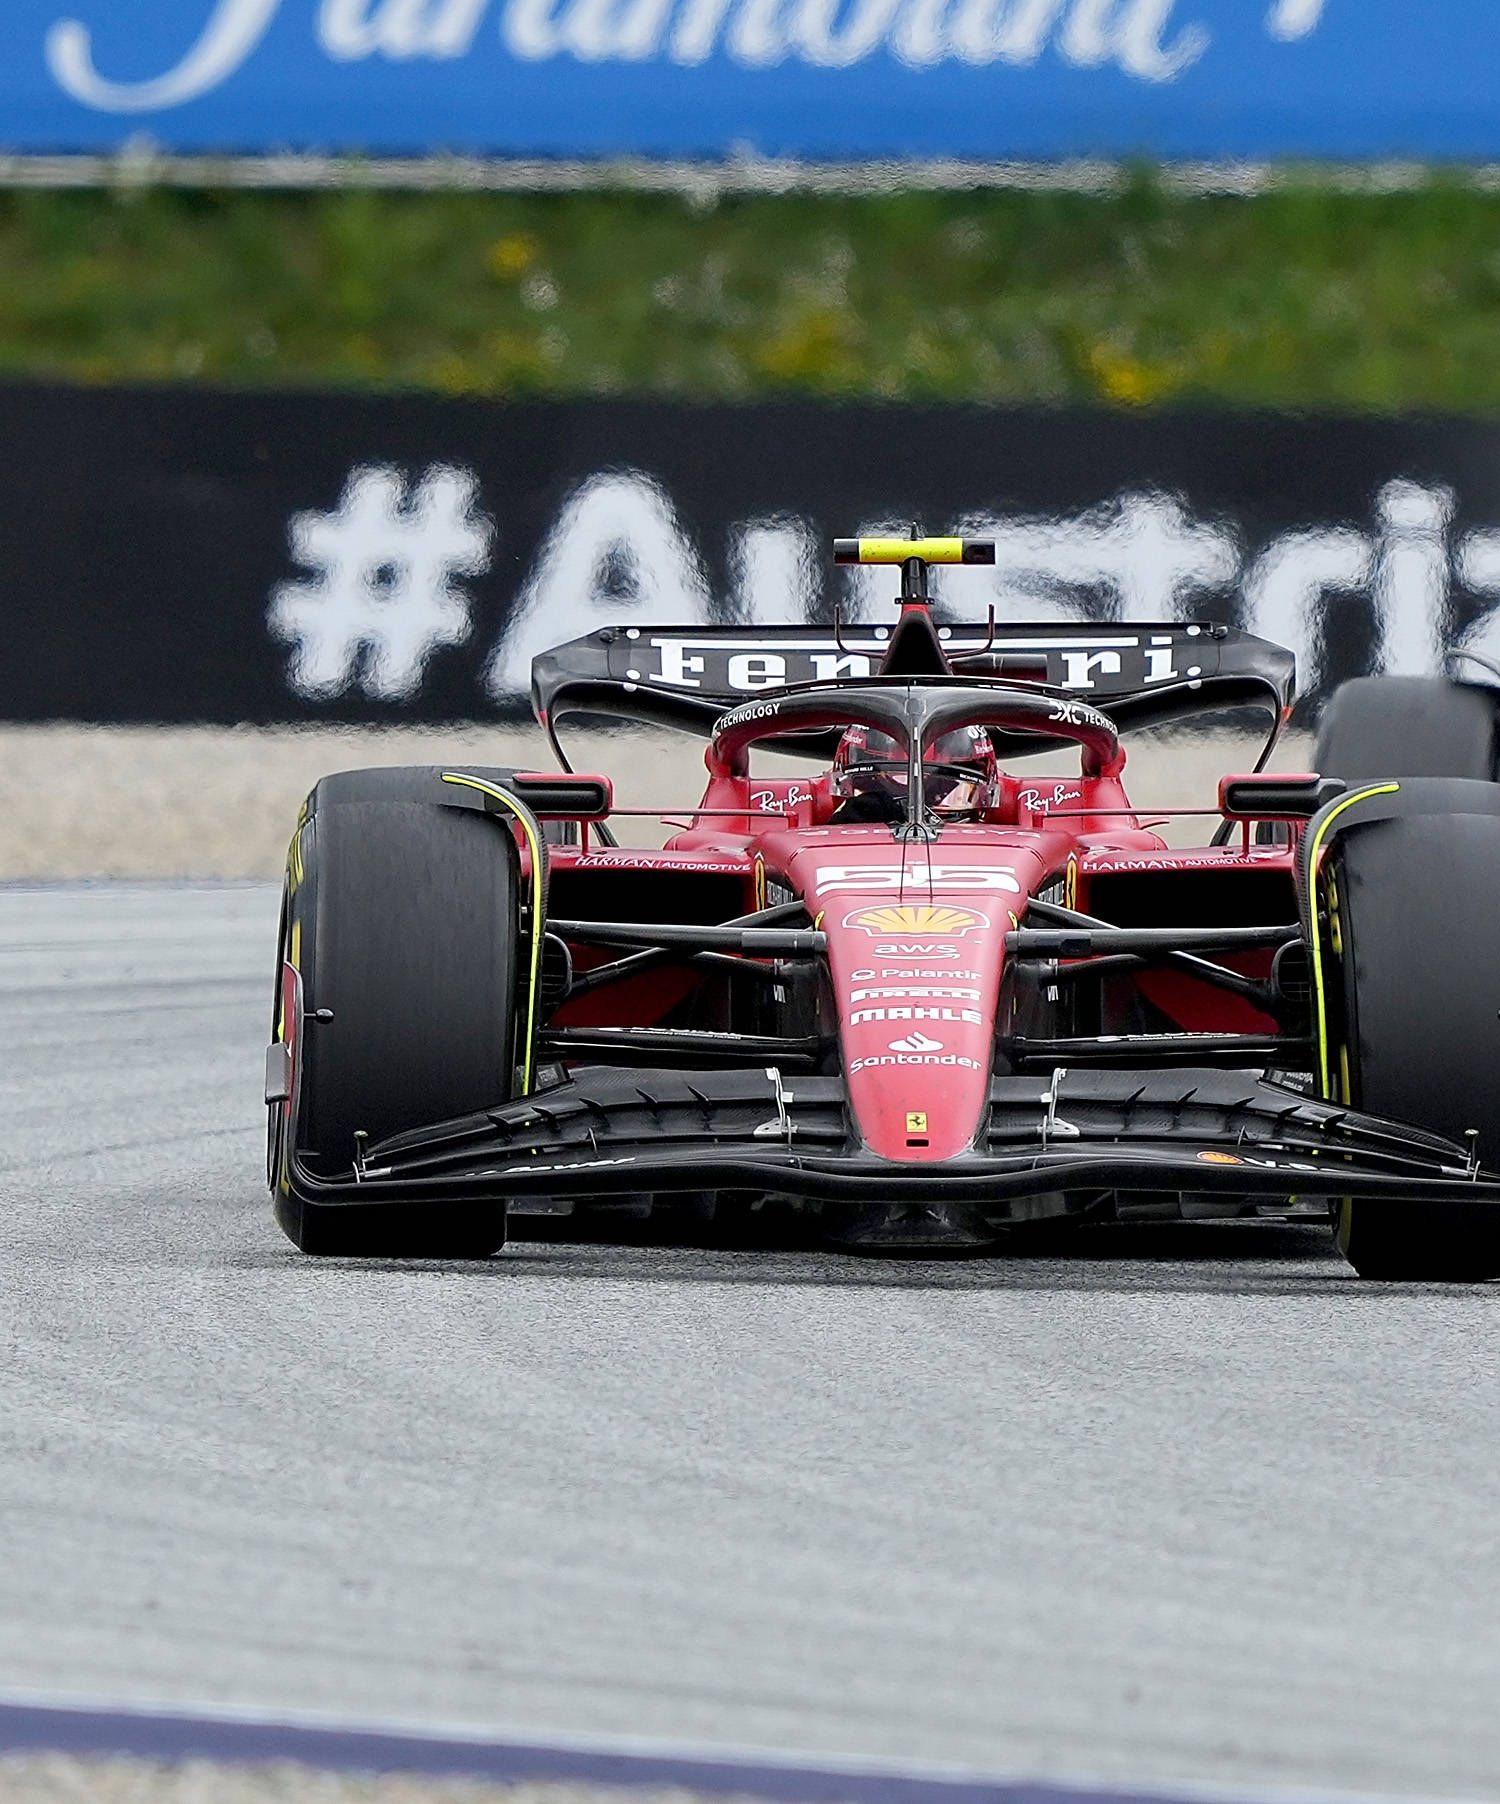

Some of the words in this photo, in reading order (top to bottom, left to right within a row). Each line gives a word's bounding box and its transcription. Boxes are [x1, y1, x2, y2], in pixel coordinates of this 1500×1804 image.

[649, 635, 1179, 691] Ferri
[719, 703, 780, 730] TECHNOLOGY
[750, 786, 813, 811] Ray-Ban
[1017, 785, 1081, 811] Ray-Ban
[575, 856, 656, 868] HARMAN
[662, 863, 751, 871] AUTOMOTIVE
[1082, 859, 1179, 871] HARMAN
[1185, 858, 1258, 866] AUTOMOTIVE
[815, 863, 1021, 897] 55
[875, 943, 958, 954] aws
[881, 968, 982, 980] Palantir
[850, 1007, 981, 1026] MAHLE
